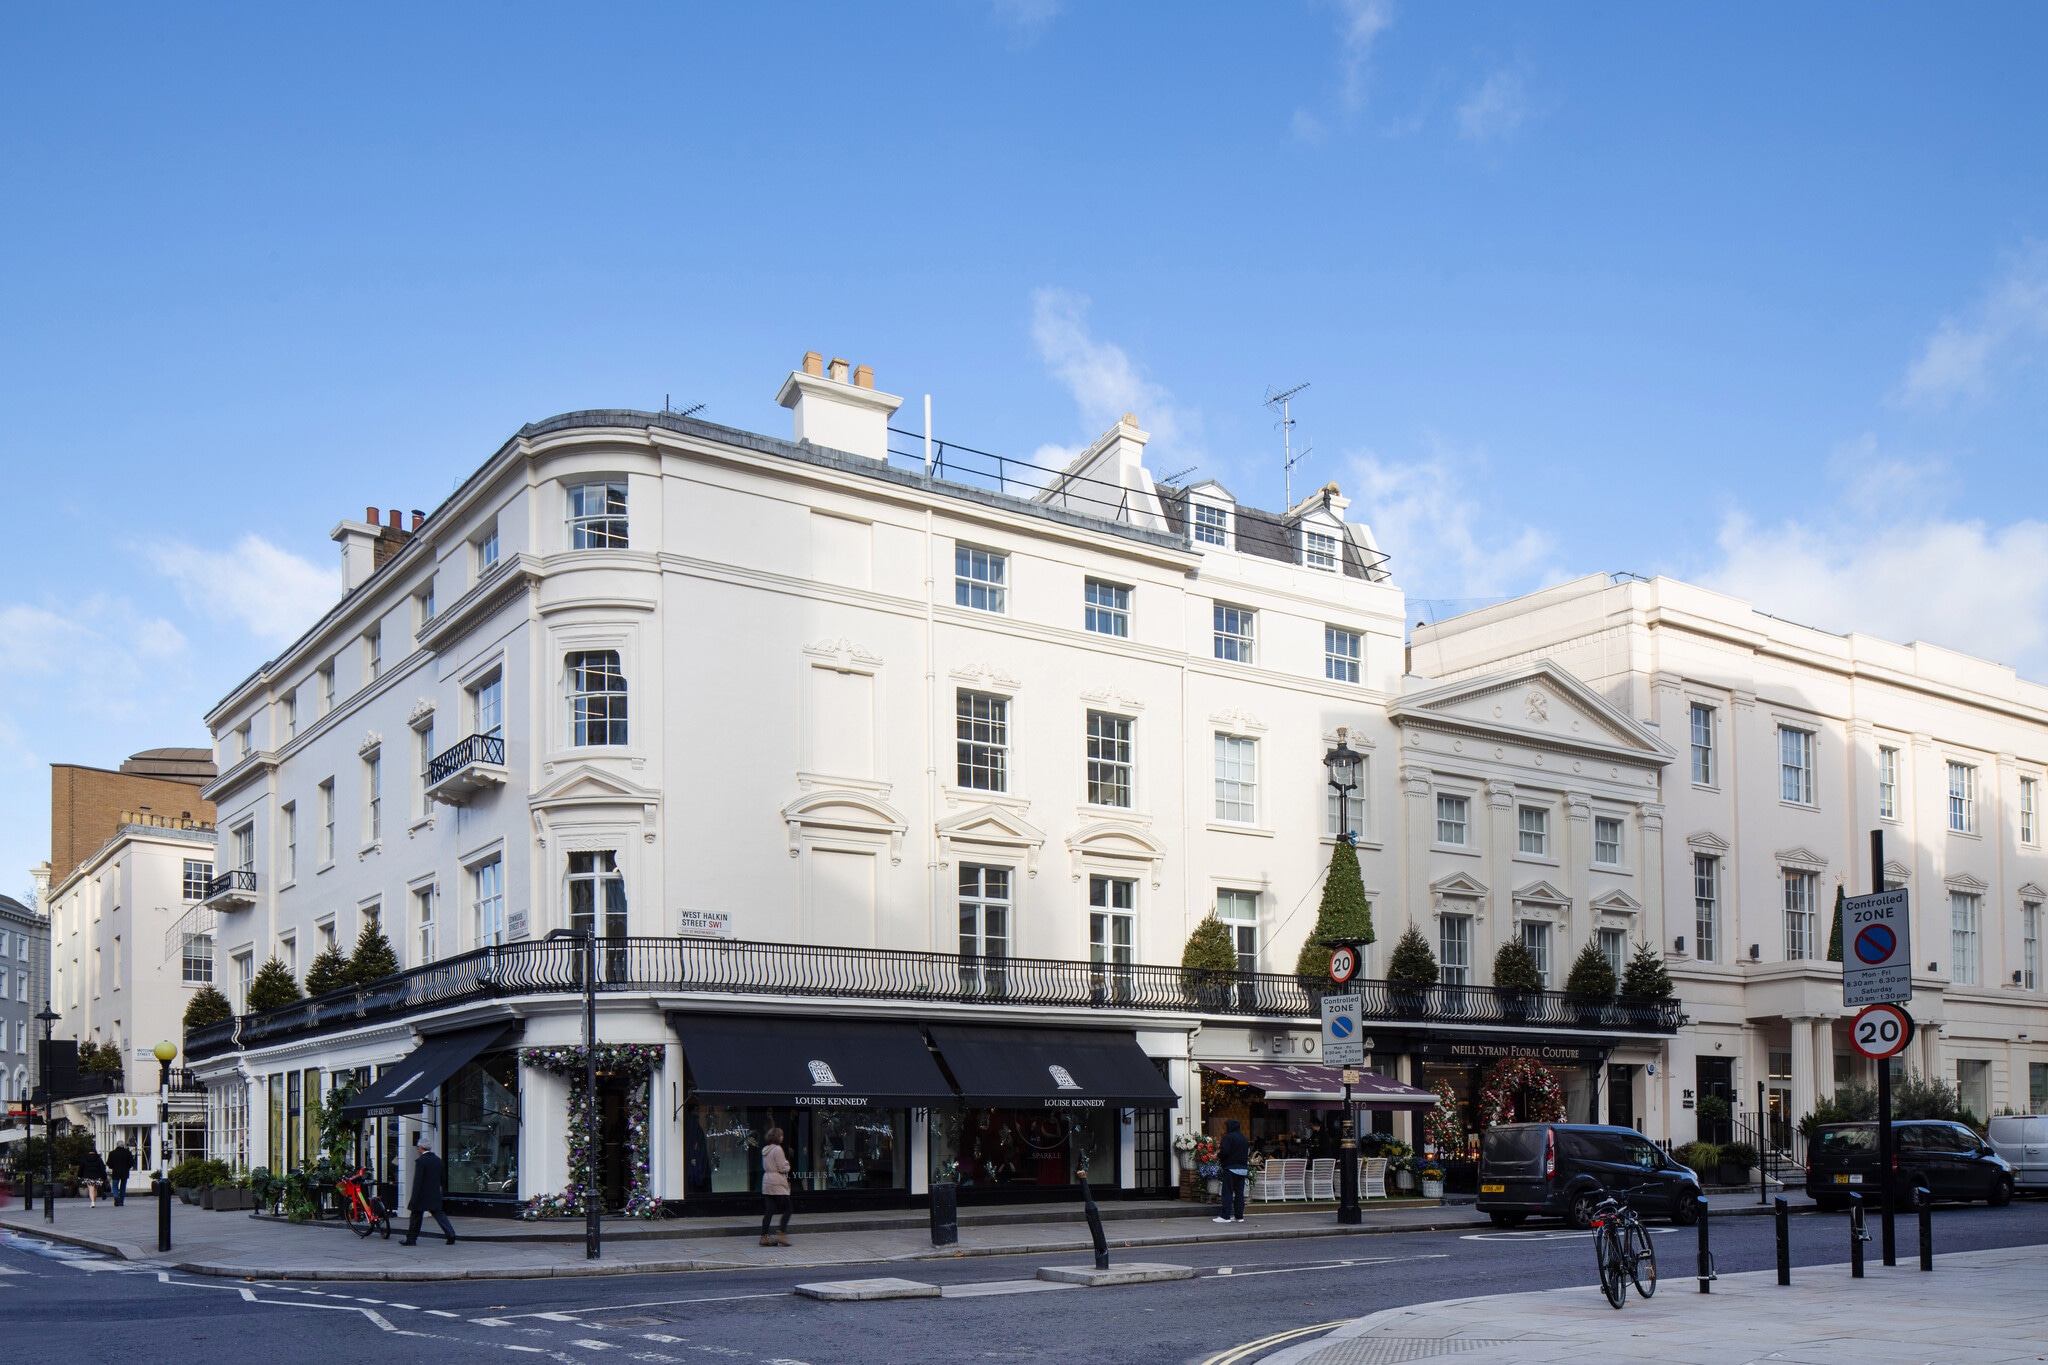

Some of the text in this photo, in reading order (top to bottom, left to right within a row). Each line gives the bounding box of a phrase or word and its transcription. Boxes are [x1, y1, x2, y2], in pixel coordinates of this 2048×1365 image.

[1846, 894, 1903, 911] Controlled
[682, 911, 728, 921] WEST HALKIN
[1854, 907, 1894, 923] ZONE
[681, 919, 722, 929] STREET SW1
[1334, 956, 1350, 972] 20
[1861, 971, 1877, 979] Mon
[1881, 969, 1892, 977] Fri
[1846, 980, 1863, 988] 8.30
[1878, 976, 1896, 985] 6.30
[1897, 976, 1908, 984] pm
[1861, 986, 1893, 995] Saturday
[1324, 996, 1359, 1005] Controlled
[1847, 996, 1864, 1004] 8.30
[1880, 992, 1896, 1000] 1.30
[1329, 1004, 1354, 1013] ZONE
[1859, 1019, 1899, 1044] 20
[1451, 1045, 1580, 1058] NEILL STRAIN FLORAL COUTURE
[795, 1097, 868, 1106] LOUISE KENNEDY
[1044, 1099, 1106, 1107] LOUISE KENNEDY
